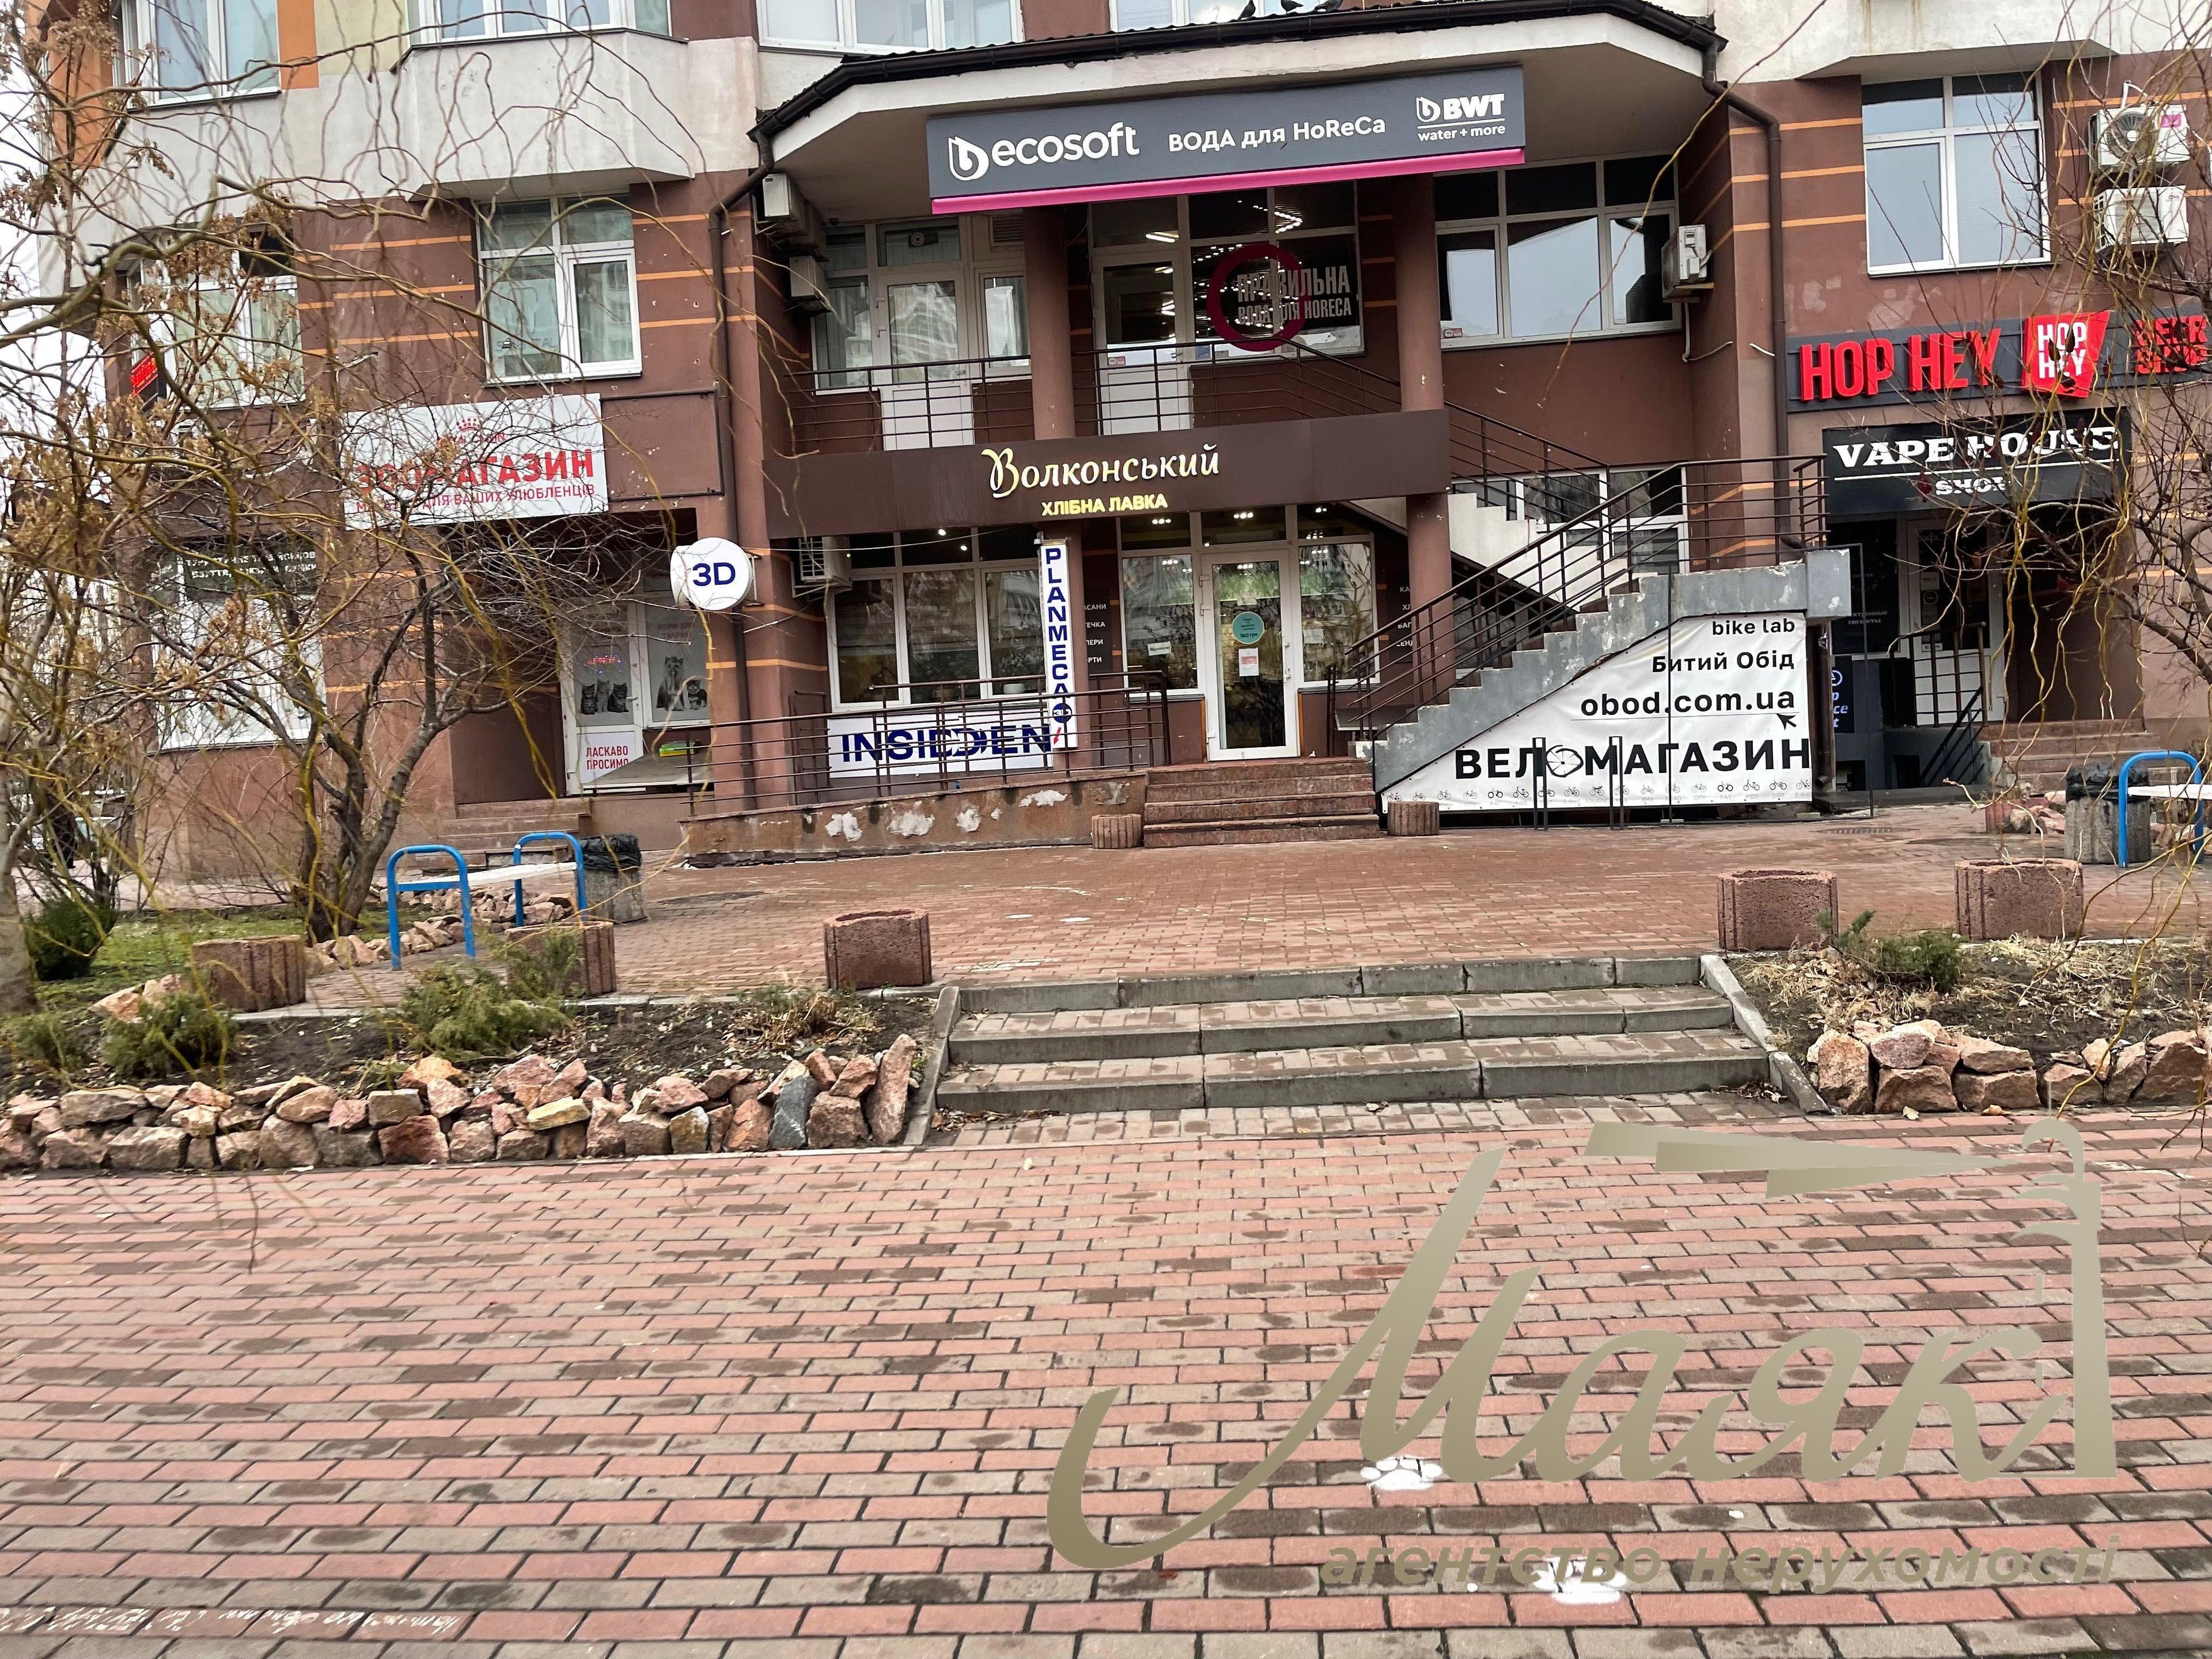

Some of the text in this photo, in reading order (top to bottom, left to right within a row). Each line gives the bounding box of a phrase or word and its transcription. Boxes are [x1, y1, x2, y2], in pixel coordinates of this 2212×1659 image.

[1443, 93, 1505, 120] BWT
[991, 121, 1139, 166] ecosoft
[1168, 116, 1386, 153] ВОДА для HoReCa
[1418, 128, 1457, 142] water
[1470, 125, 1506, 137] more
[1304, 297, 1352, 319] HORECA
[2037, 322, 2087, 351] HOP
[1800, 328, 2002, 402] HOP HEY
[1832, 435, 1955, 468] VAPE
[980, 444, 1219, 498] Волконський
[454, 492, 503, 506] ВАШИХ
[507, 483, 596, 501] УЛЮБЛЕНЦІВ
[1041, 493, 1168, 516] ХЛІБНА ЛАВКА
[692, 562, 736, 587] 3D
[1046, 547, 1069, 695] PLANMECA
[1711, 618, 1796, 636] bike lab
[1652, 650, 1795, 673] Битий Обід
[1581, 690, 1795, 717] obod.com.ua
[586, 745, 628, 757] ЛАСКАВО
[586, 758, 628, 770] ПРОСИМО
